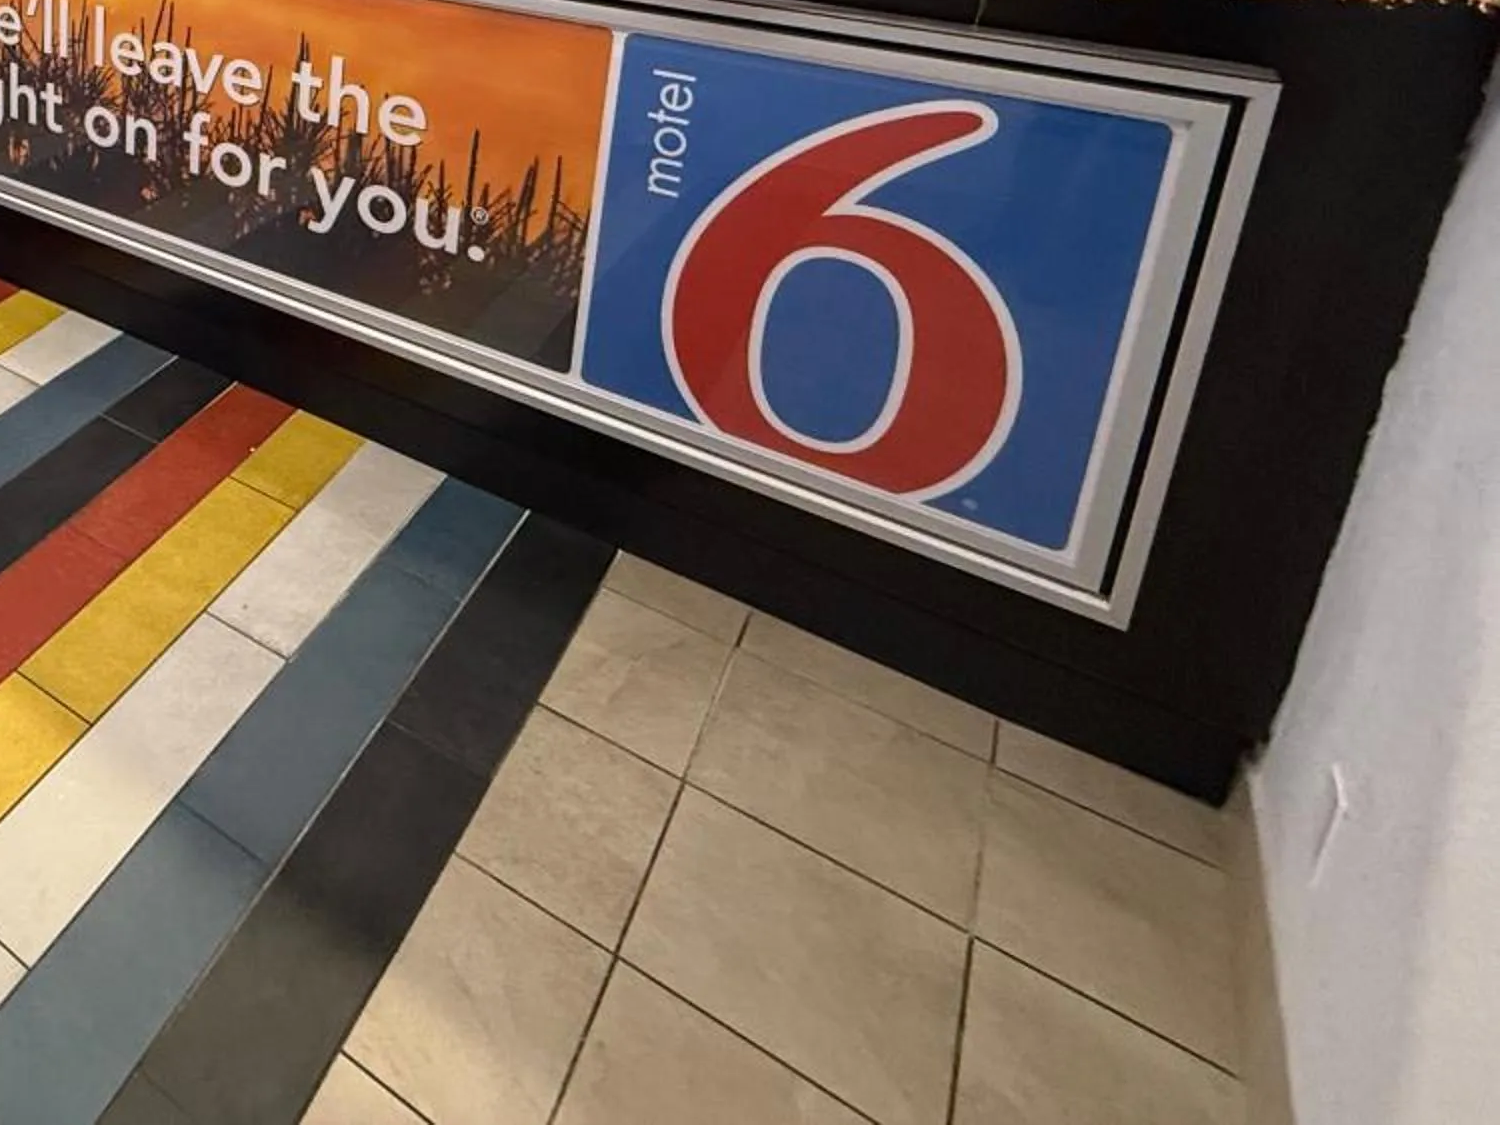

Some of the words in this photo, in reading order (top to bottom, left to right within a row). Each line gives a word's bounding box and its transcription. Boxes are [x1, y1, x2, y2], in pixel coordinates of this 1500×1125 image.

[95, 4, 263, 106] leave
[291, 55, 428, 147] the
[647, 69, 697, 199] motel
[84, 105, 159, 162] on
[183, 113, 287, 198] for
[308, 166, 485, 263] you.
[661, 99, 1024, 504] 6
